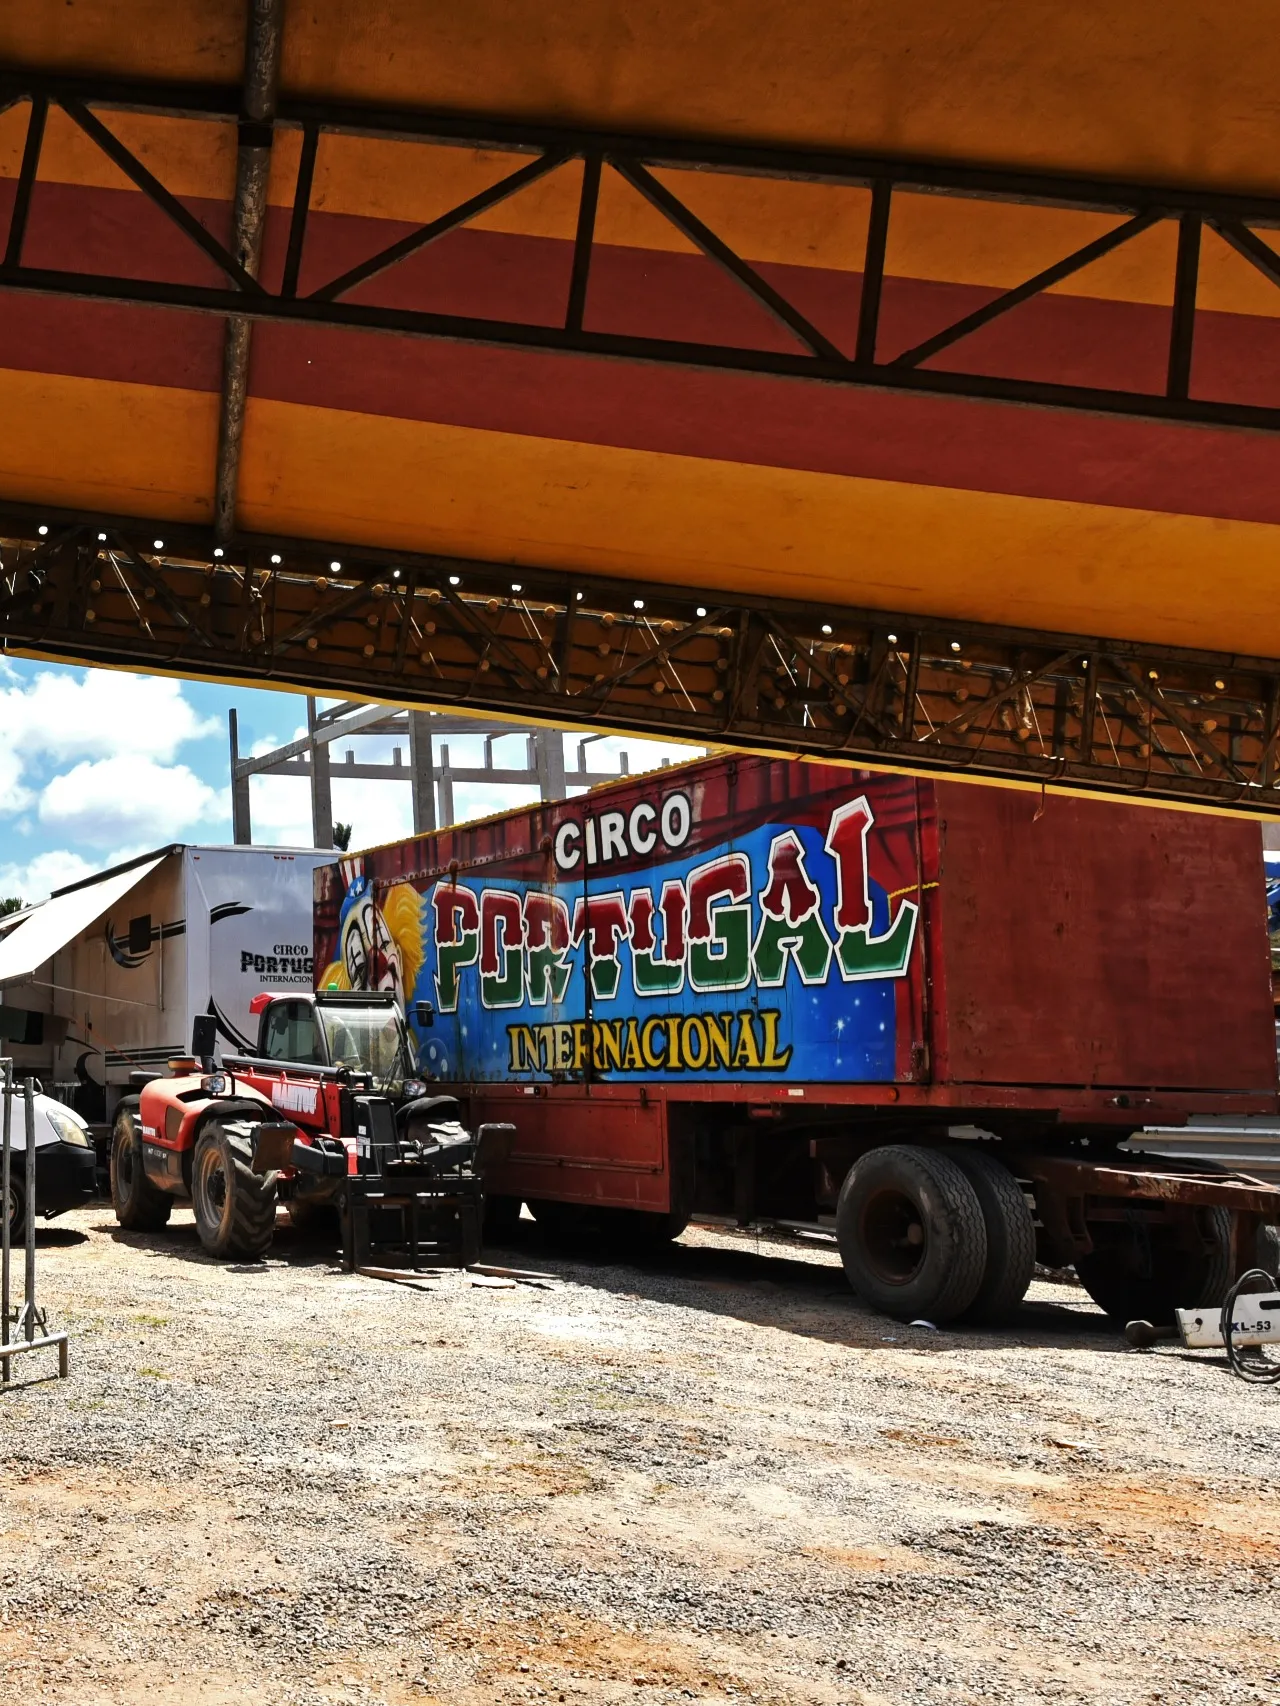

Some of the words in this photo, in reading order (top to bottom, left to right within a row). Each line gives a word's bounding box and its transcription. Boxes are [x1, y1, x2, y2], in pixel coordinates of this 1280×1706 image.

[554, 793, 692, 870] CIRCO
[431, 795, 919, 1014] PORTUGAL
[273, 944, 309, 956] CIRCO
[506, 1009, 794, 1073] INTERNACIONAL
